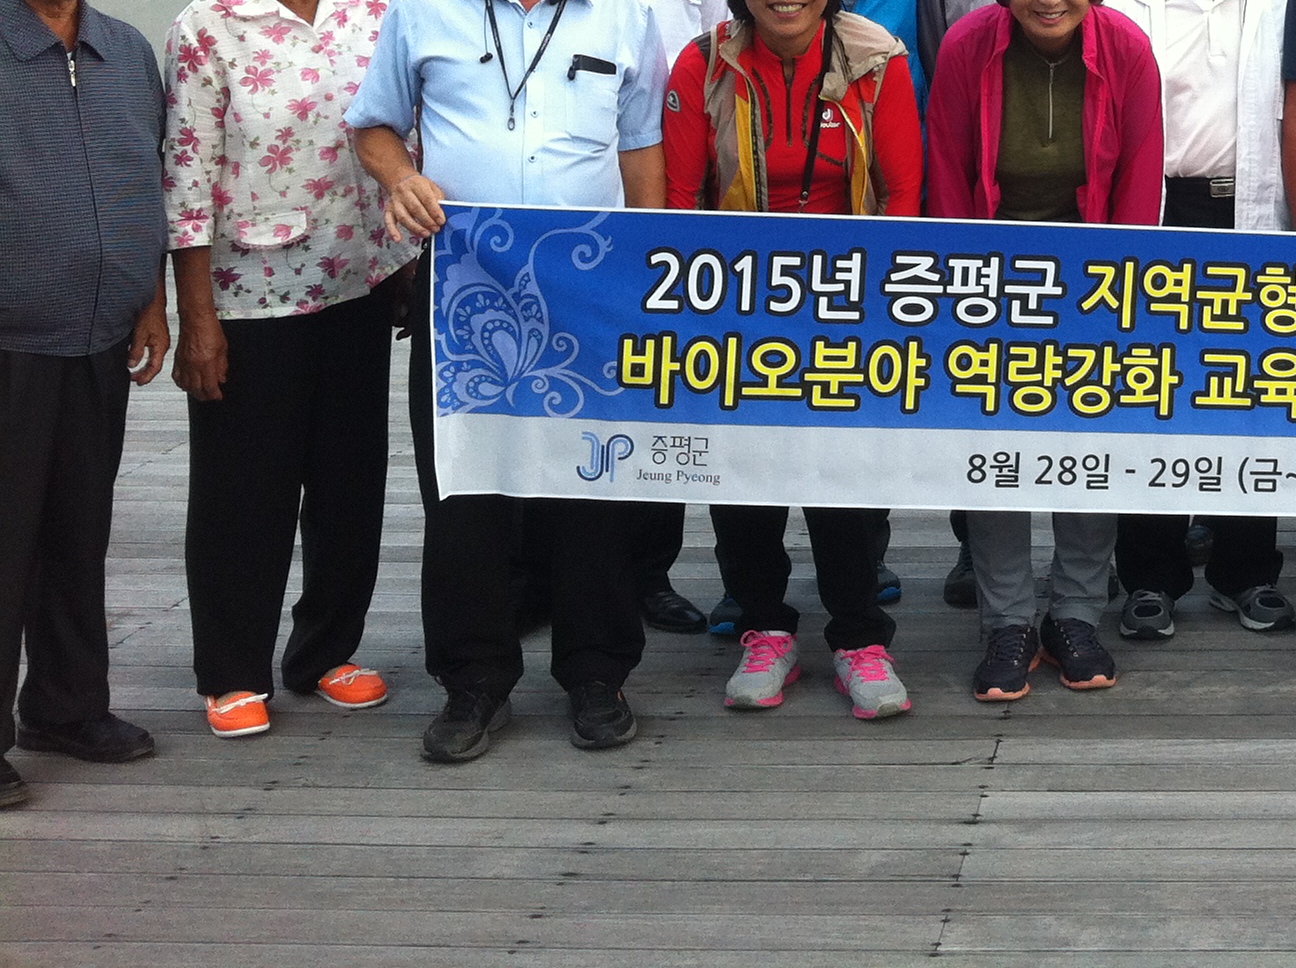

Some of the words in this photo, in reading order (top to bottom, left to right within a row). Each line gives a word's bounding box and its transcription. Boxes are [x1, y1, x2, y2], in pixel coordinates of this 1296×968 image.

[643, 249, 864, 322] 2015년
[882, 253, 1064, 326] 증평군
[620, 335, 928, 411] 바이오분야
[946, 342, 1180, 416] 역량강화
[650, 435, 710, 467] 증평군
[965, 451, 1021, 489] 8월
[1034, 453, 1111, 491] 28일
[1147, 455, 1223, 493] 29일
[636, 468, 673, 483] Jeung
[675, 470, 721, 486] Pyeong
